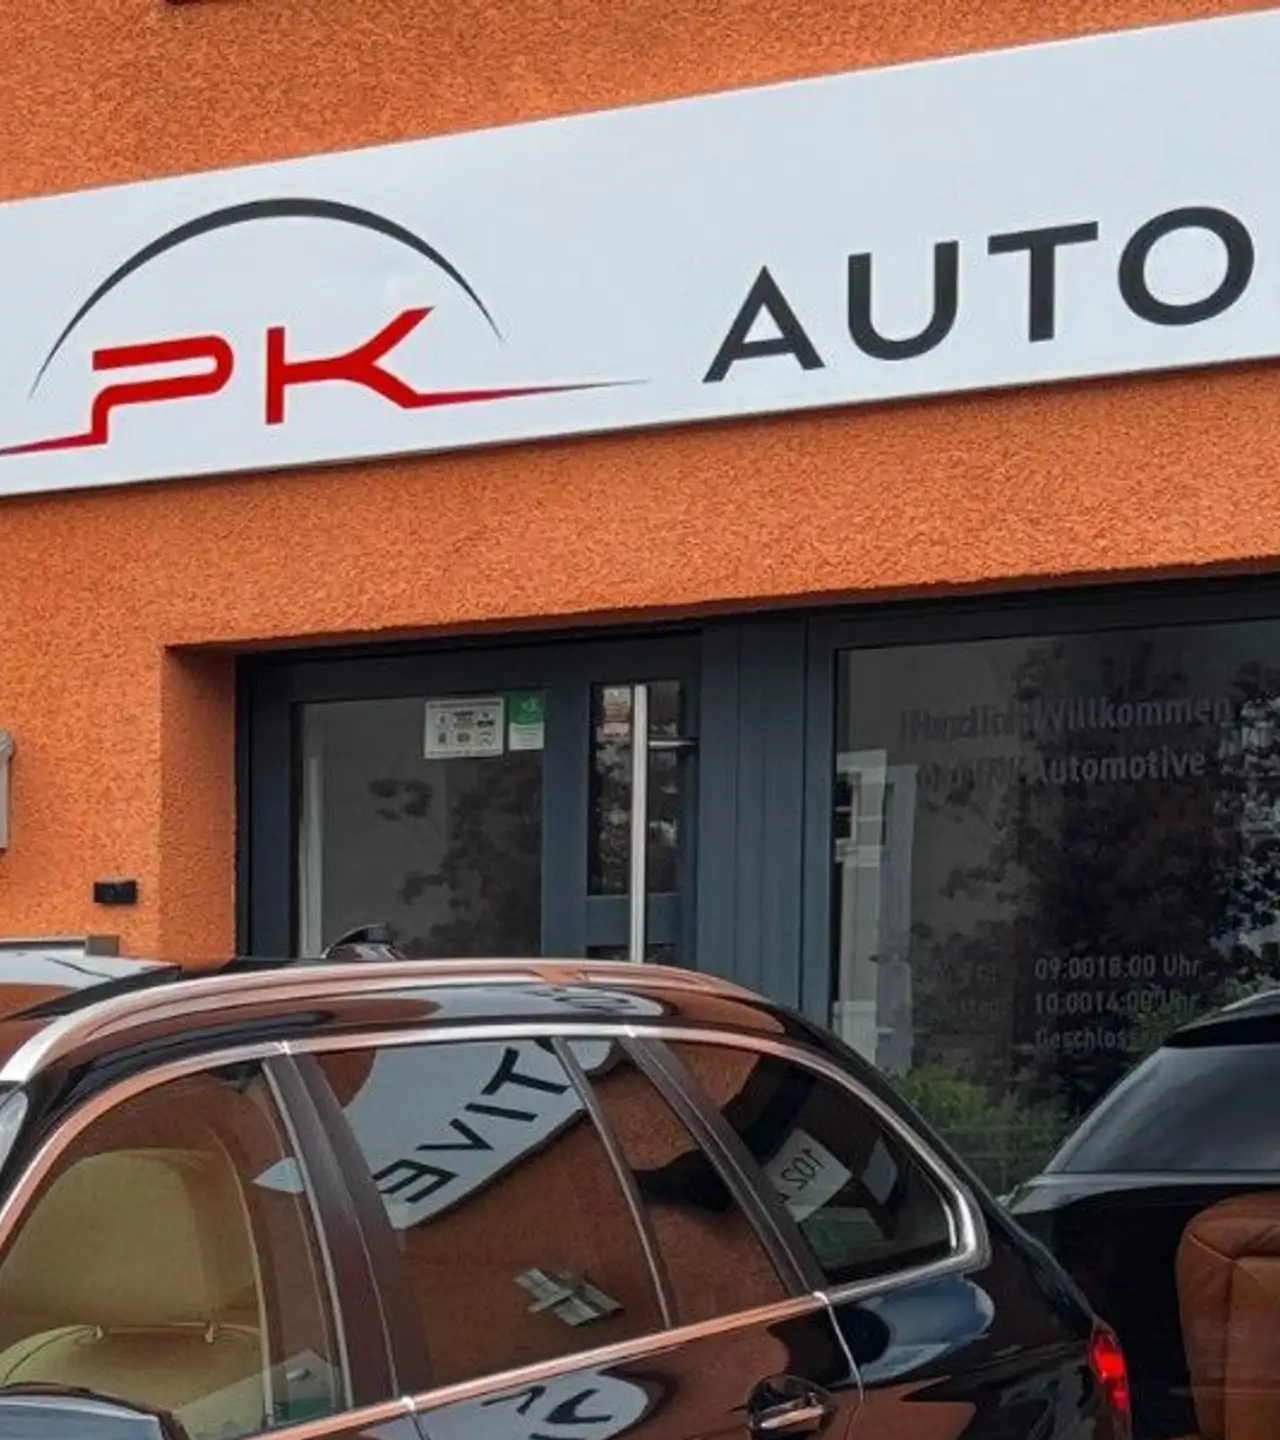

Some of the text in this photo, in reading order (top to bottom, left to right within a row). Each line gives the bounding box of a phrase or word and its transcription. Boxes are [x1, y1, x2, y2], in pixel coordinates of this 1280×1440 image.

[702, 206, 1255, 383] AUTO
[91, 306, 435, 444] PK
[1038, 697, 1234, 732] Willkommen
[1037, 744, 1206, 784] Automotive
